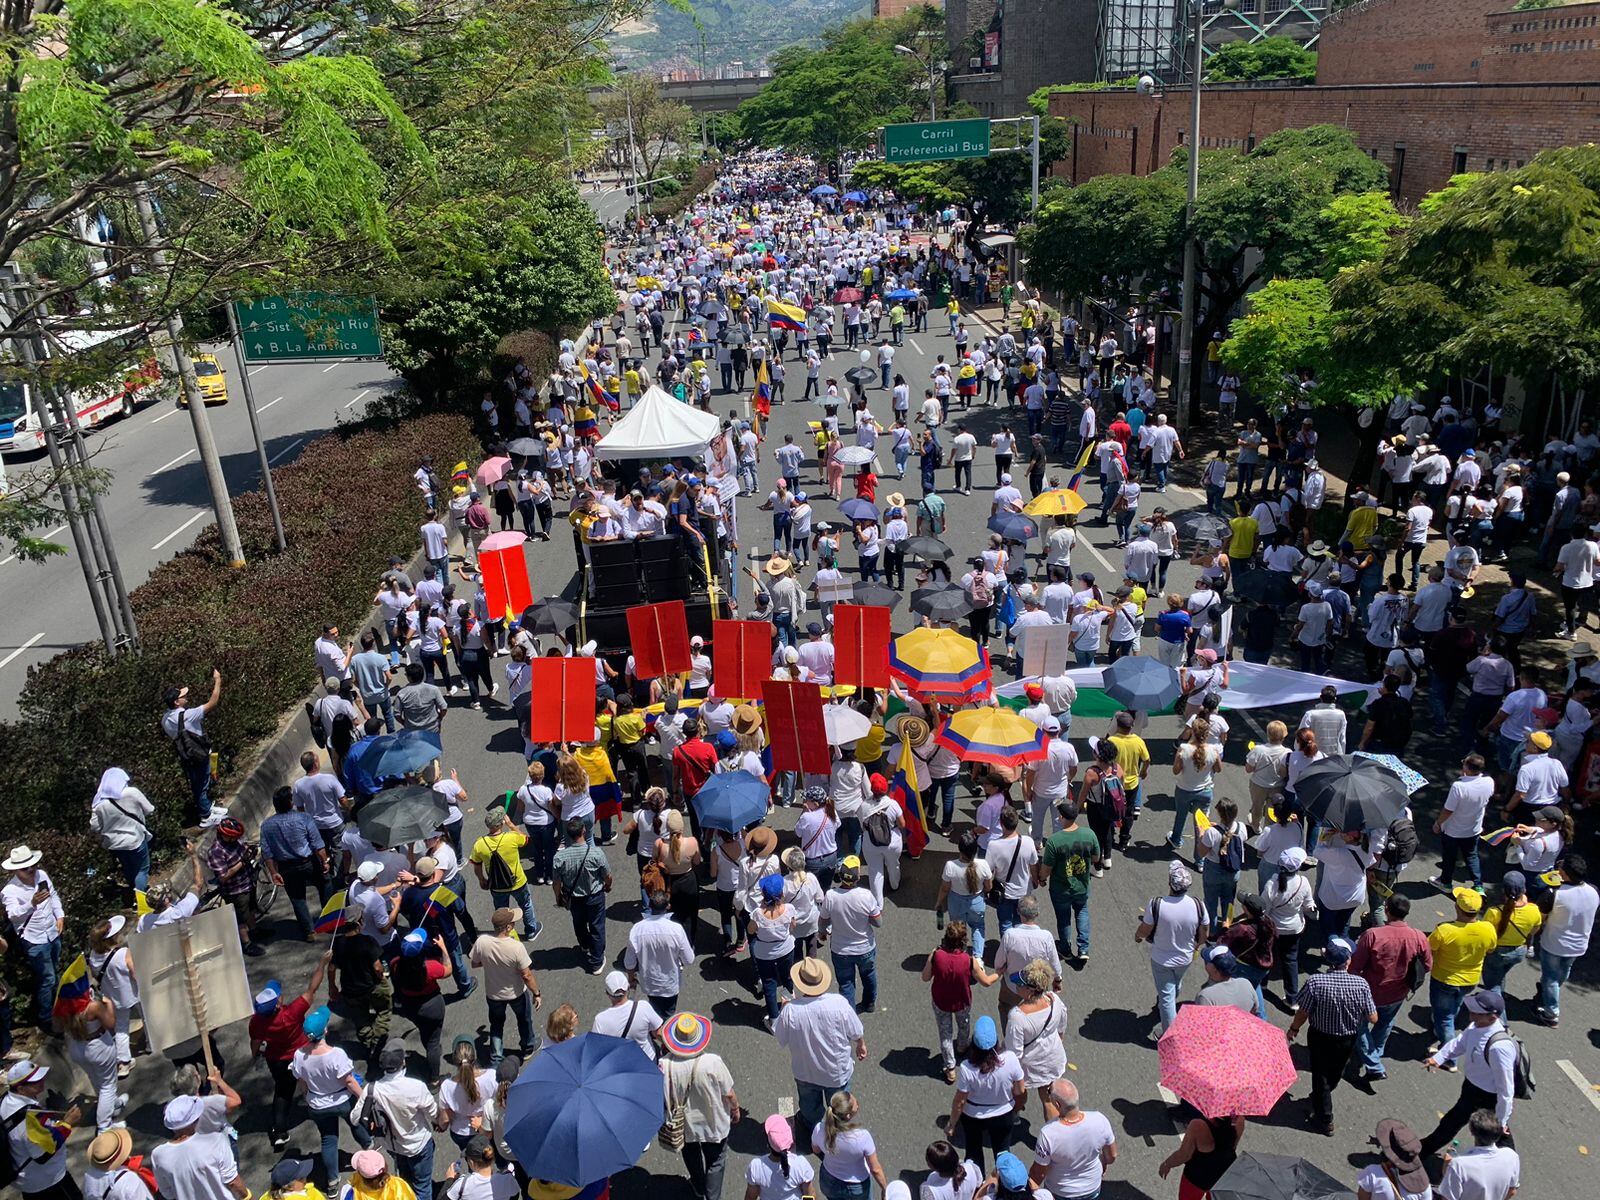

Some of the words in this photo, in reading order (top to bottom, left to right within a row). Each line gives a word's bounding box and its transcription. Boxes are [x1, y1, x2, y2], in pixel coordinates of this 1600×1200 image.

[921, 129, 954, 139] Carril
[890, 144, 958, 157] Preferencial
[962, 141, 984, 152] Bus
[262, 300, 277, 310] La
[269, 342, 282, 353] B.
[286, 341, 301, 352] La
